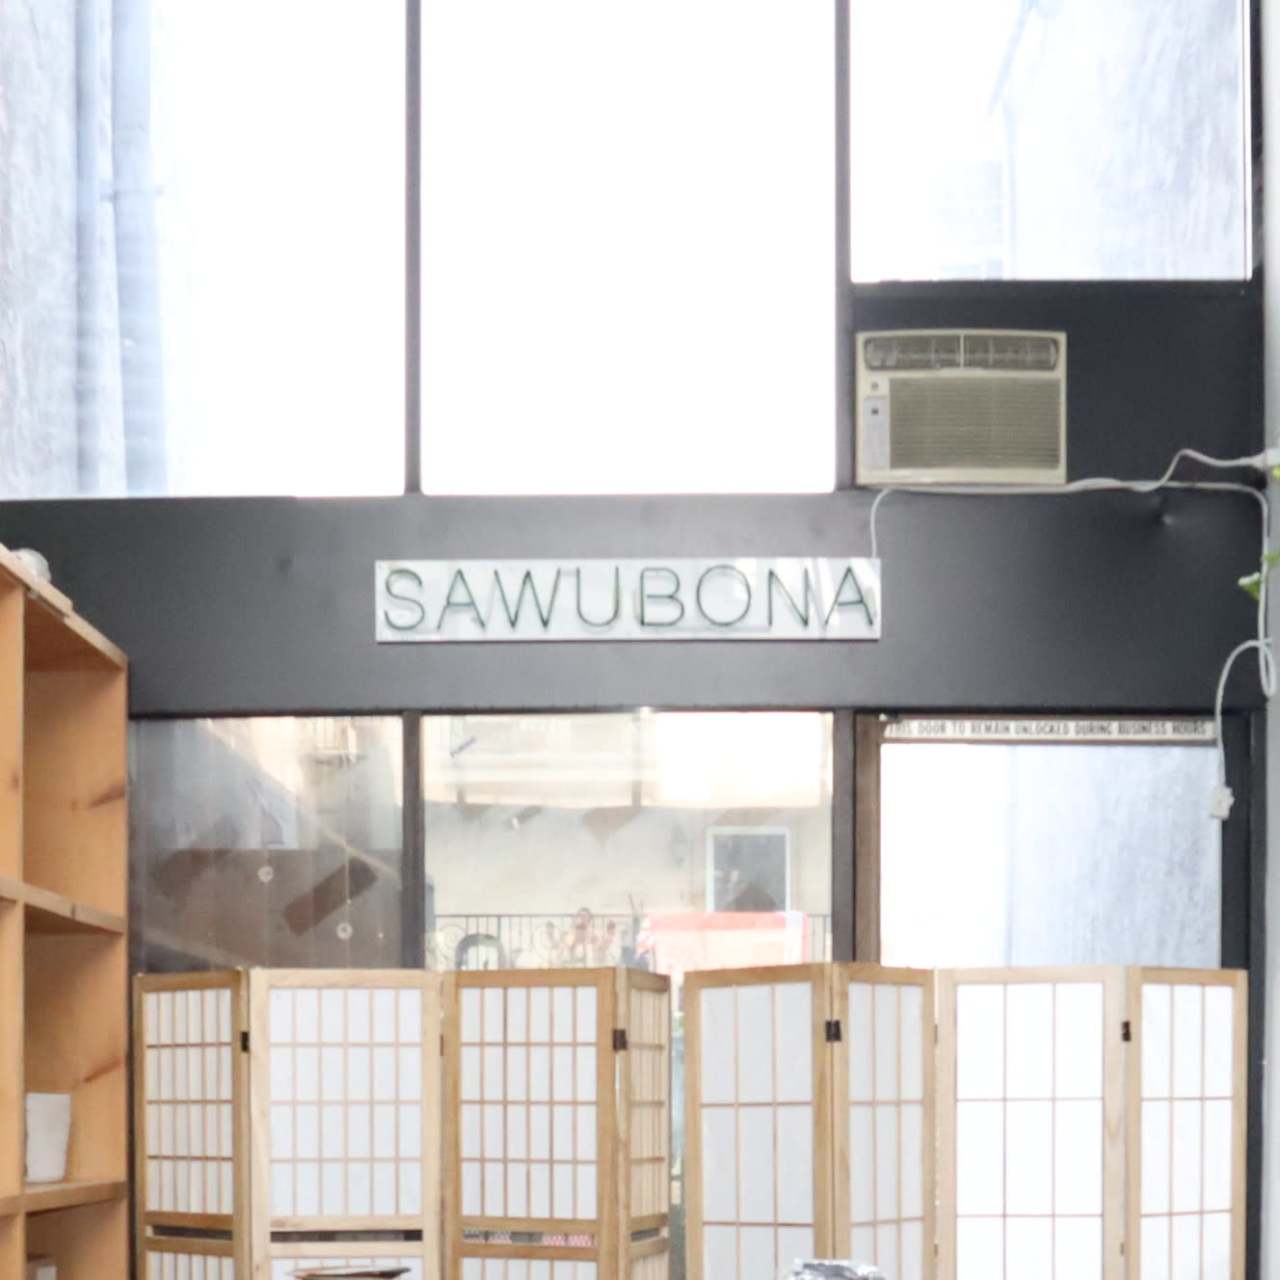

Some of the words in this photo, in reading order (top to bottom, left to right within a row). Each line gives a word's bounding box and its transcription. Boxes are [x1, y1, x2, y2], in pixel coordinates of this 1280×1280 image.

[383, 565, 874, 632] SAWUBONA
[919, 721, 947, 735] DOOR
[951, 721, 967, 735] TO
[971, 721, 1011, 735] REMAIN
[1015, 721, 1071, 735] UNLOCKED
[1074, 721, 1114, 736] DURING
[1119, 721, 1169, 736] BUSINESS
[1171, 721, 1207, 736] HOURS
